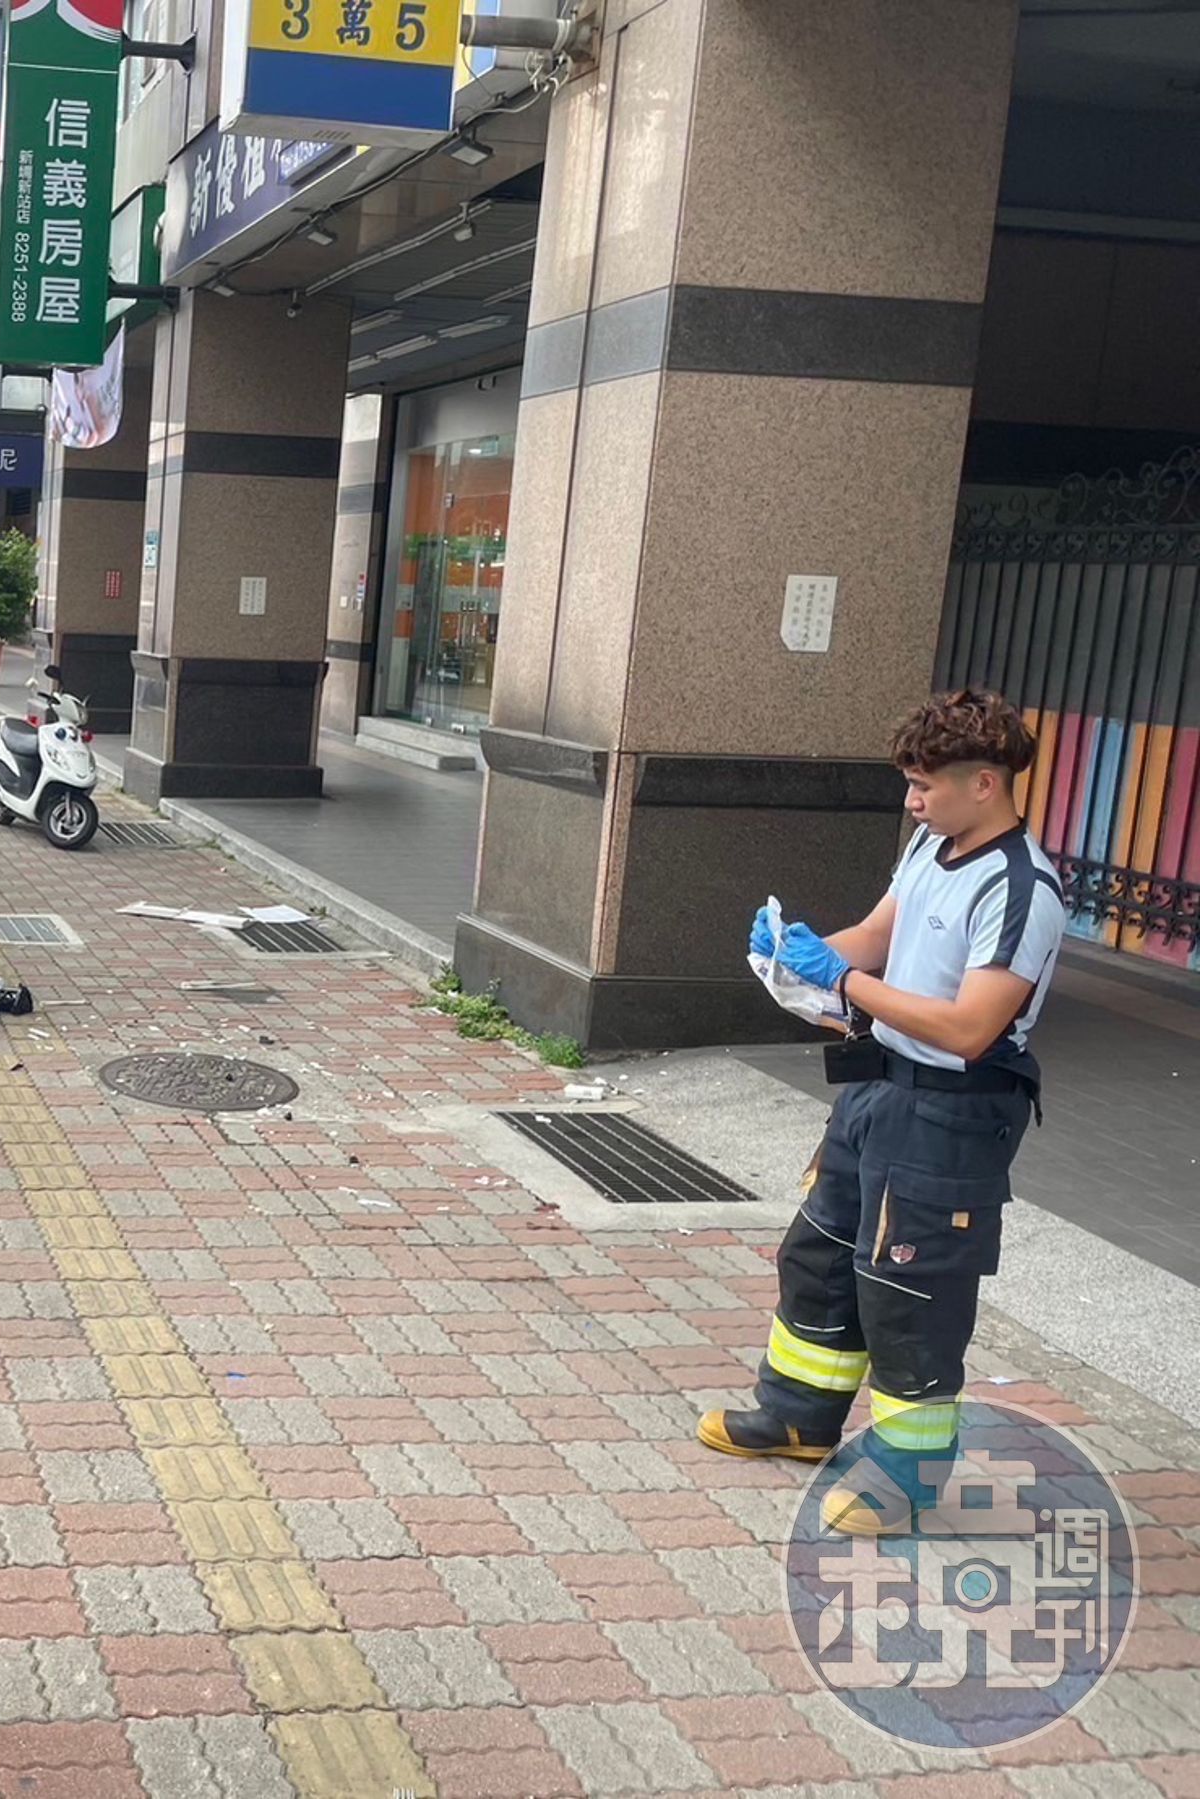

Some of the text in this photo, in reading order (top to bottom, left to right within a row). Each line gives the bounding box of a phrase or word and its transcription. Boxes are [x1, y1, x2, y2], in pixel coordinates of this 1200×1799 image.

[11, 231, 31, 323] 8251-2388
[35, 98, 91, 324] 信義房屋
